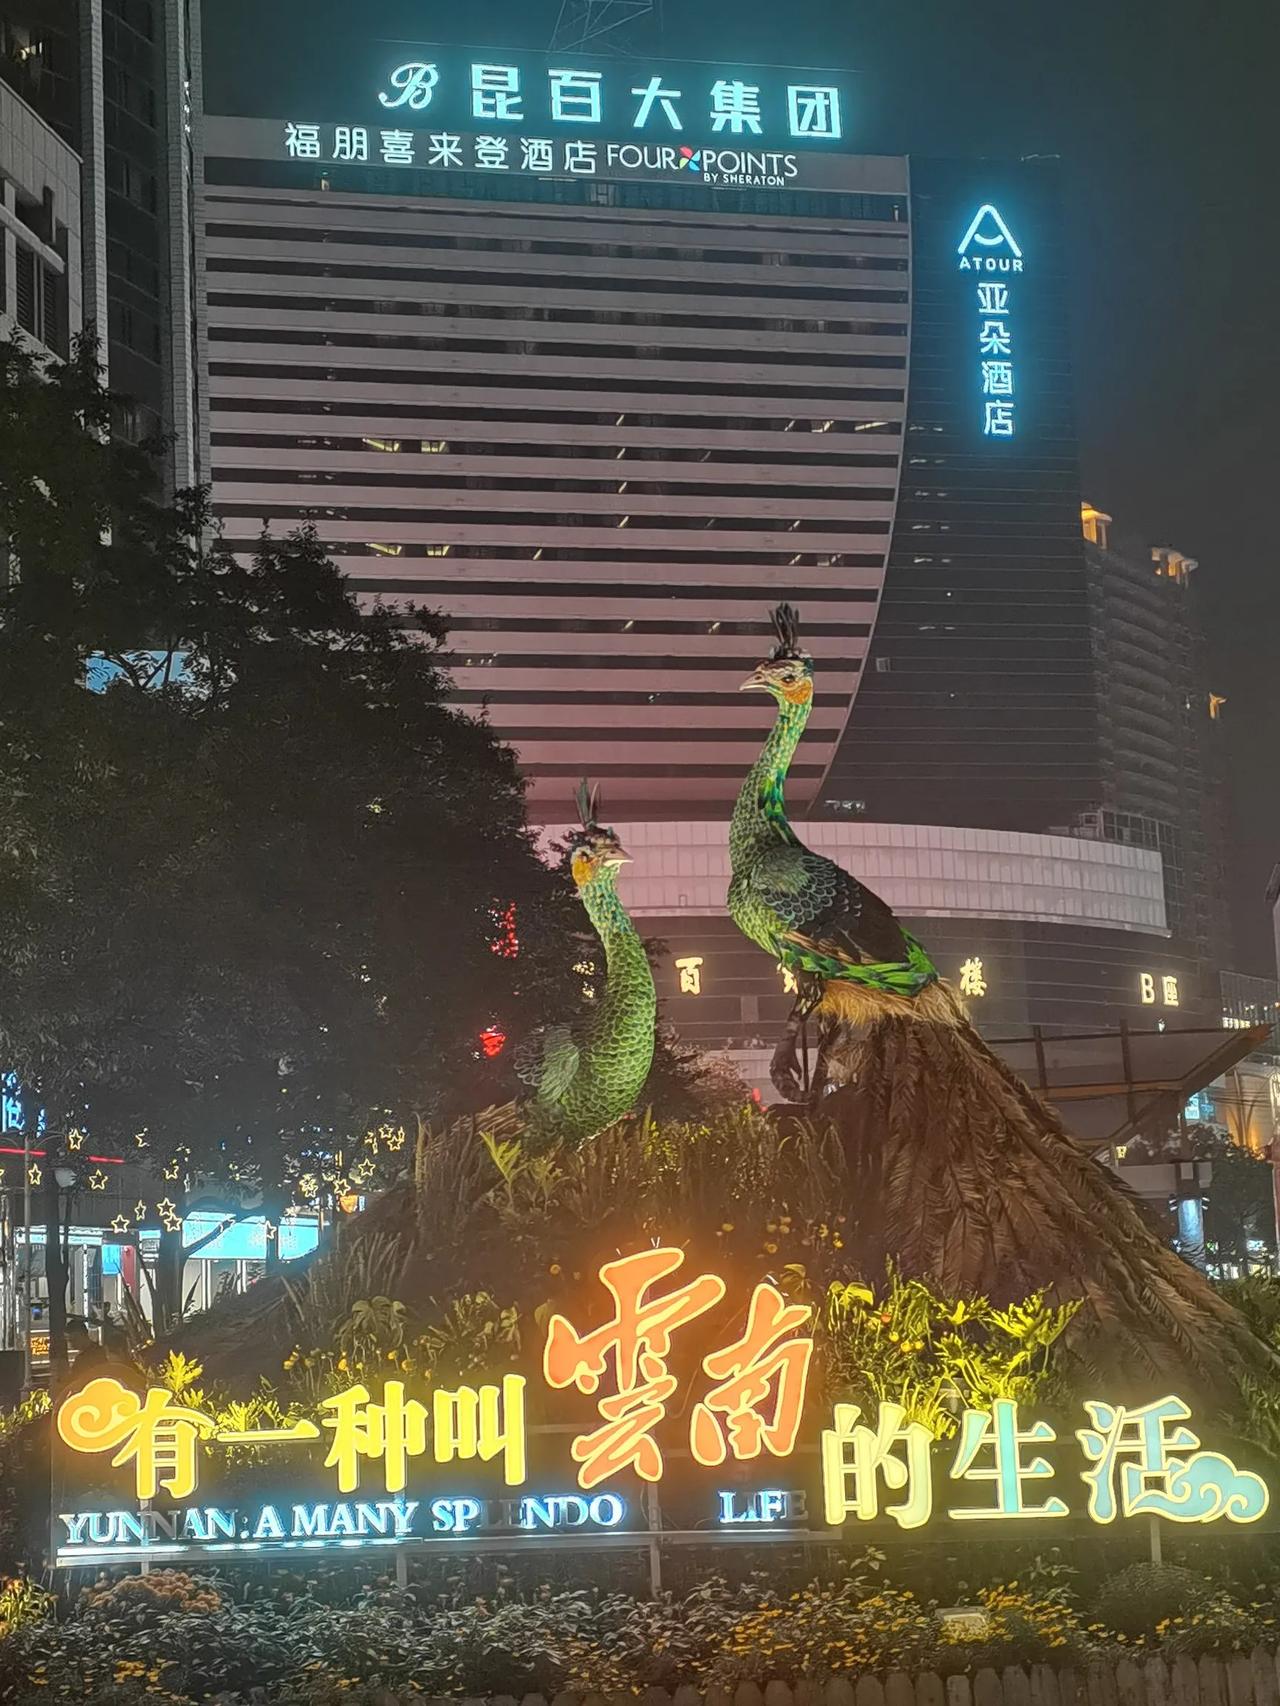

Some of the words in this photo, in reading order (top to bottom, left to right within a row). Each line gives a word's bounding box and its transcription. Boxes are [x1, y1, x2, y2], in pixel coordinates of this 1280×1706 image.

[471, 63, 842, 138] 昆百大集团
[284, 122, 598, 174] 福朋喜来登酒店
[607, 144, 680, 170] FOUR
[702, 150, 799, 177] POINTS
[703, 173, 719, 184] BY
[723, 174, 786, 187] SHERATON
[958, 256, 1024, 273] ATOUR
[976, 282, 1016, 436] 亚朵酒店
[291, 1501, 420, 1537] MANY
